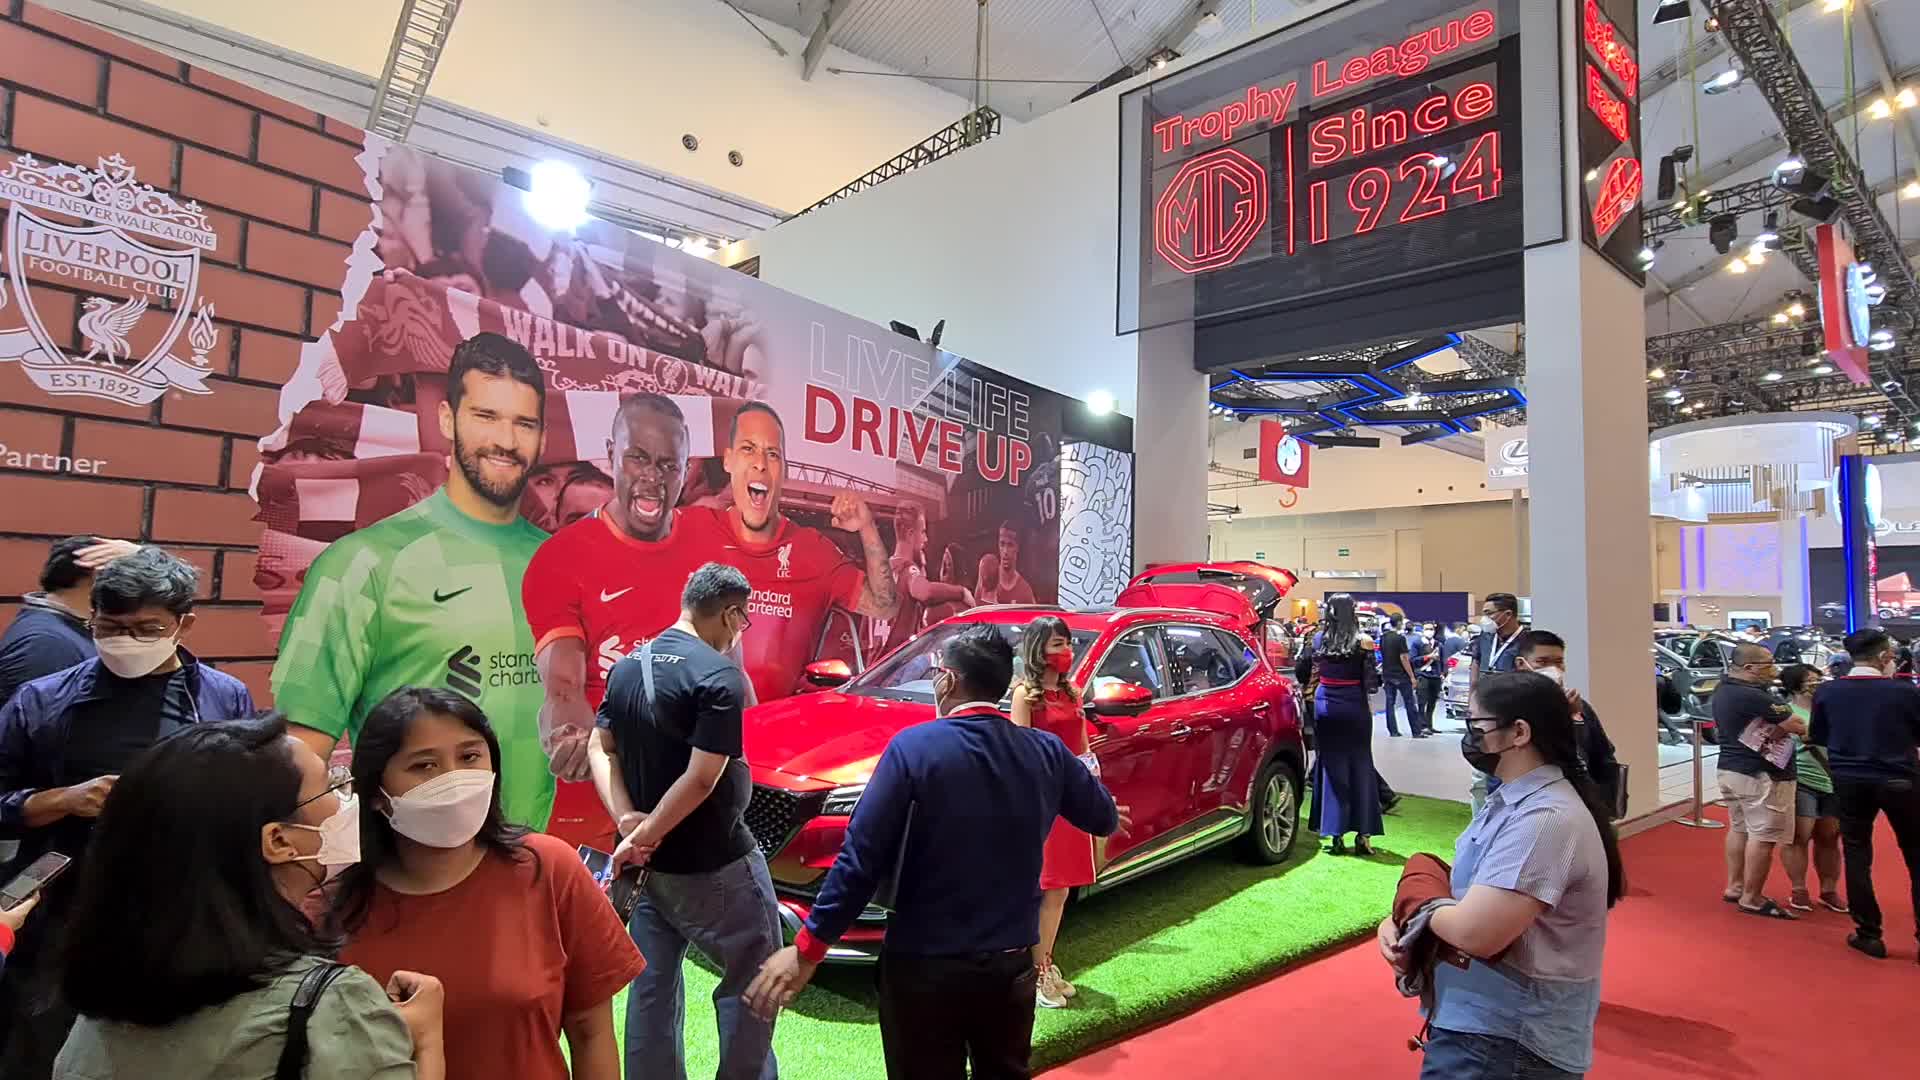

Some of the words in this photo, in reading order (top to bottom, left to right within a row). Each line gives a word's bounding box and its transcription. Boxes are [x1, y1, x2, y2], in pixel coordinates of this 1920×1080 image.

[1153, 82, 1297, 153] Trophy
[1312, 10, 1495, 97] League
[1311, 83, 1494, 164] Since
[60, 198, 113, 222] NEVER
[115, 212, 160, 233] WALK
[162, 226, 213, 247] ALONE
[1165, 162, 1256, 259] MG
[1310, 131, 1502, 245] 1924
[24, 228, 186, 284] LIVERPOOL
[29, 256, 128, 289] FOOTBALL
[132, 280, 178, 300] CLUB
[500, 304, 597, 359] WALK
[607, 338, 648, 369] ON
[809, 321, 930, 414] LIVE
[943, 368, 1030, 441] LIFE
[803, 383, 964, 475] DRIVE
[975, 429, 1032, 486] UP
[1034, 487, 1056, 526] 10
